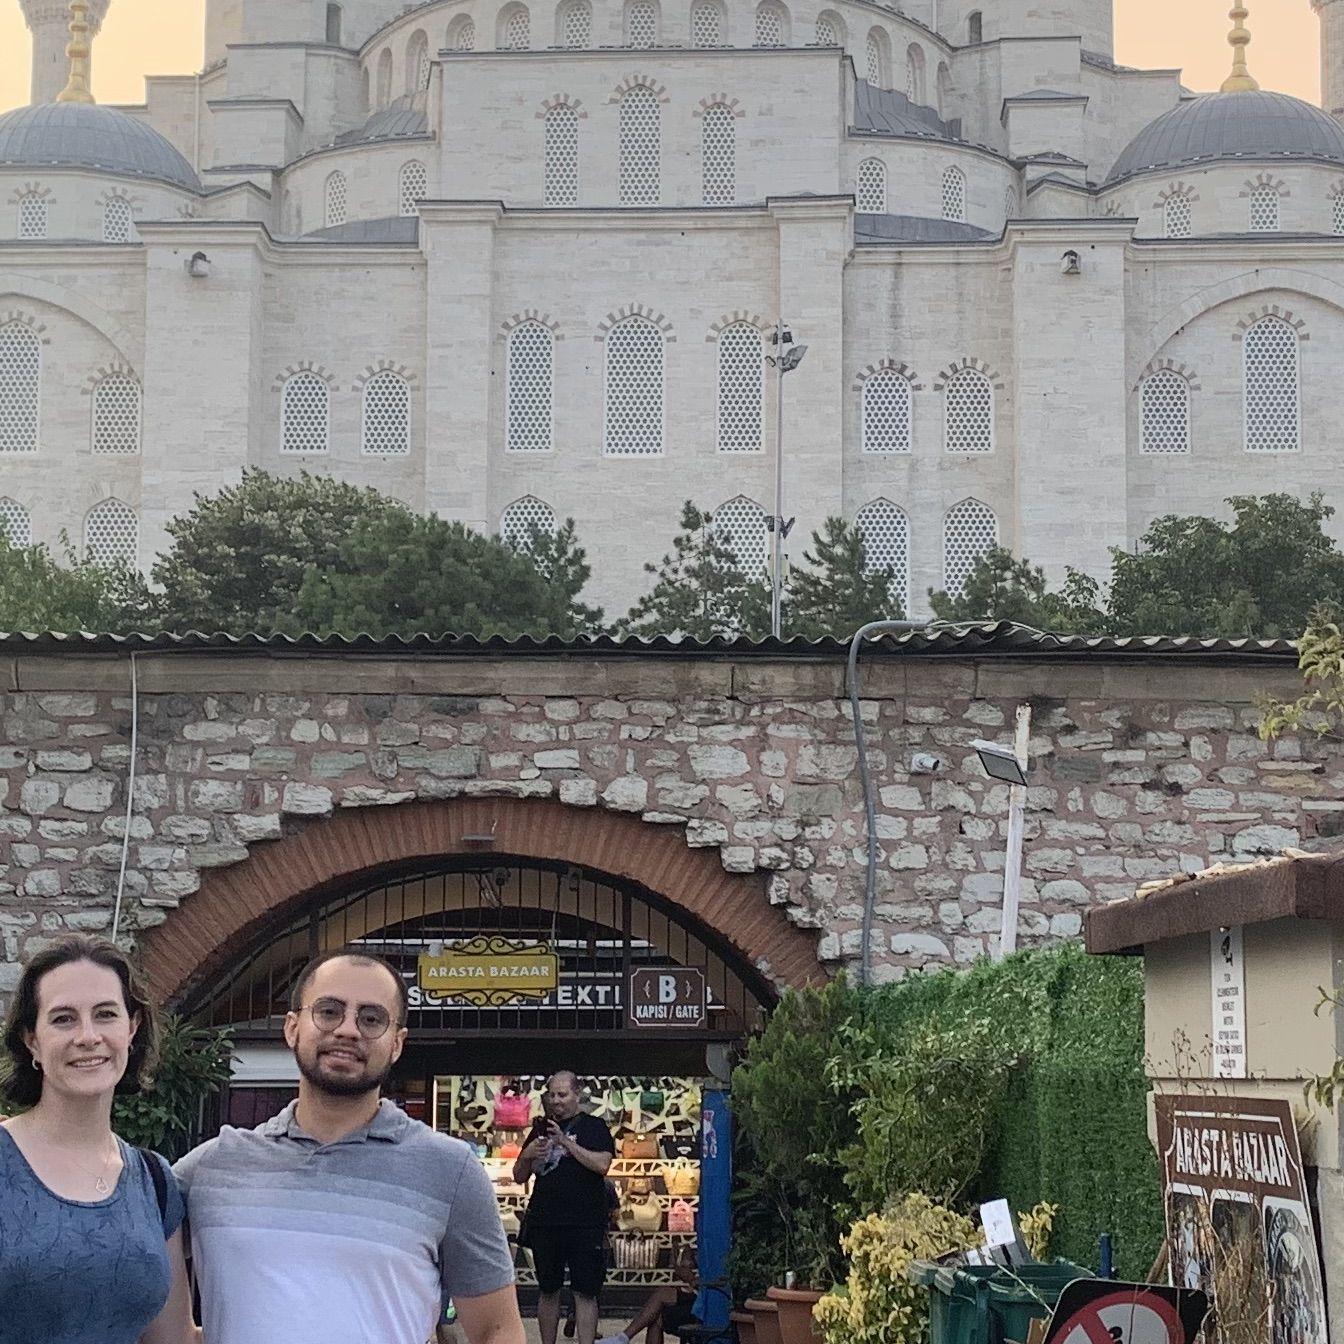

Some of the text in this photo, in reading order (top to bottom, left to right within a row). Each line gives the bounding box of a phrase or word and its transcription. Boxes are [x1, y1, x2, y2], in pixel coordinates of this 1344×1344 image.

[427, 965, 550, 978] ARASTA BAZAAR
[659, 975, 677, 1003] B
[636, 1005, 667, 1019] KAPISI
[676, 1005, 699, 1019] GATE
[1176, 1126, 1292, 1187] ARASTA BAZAAR
